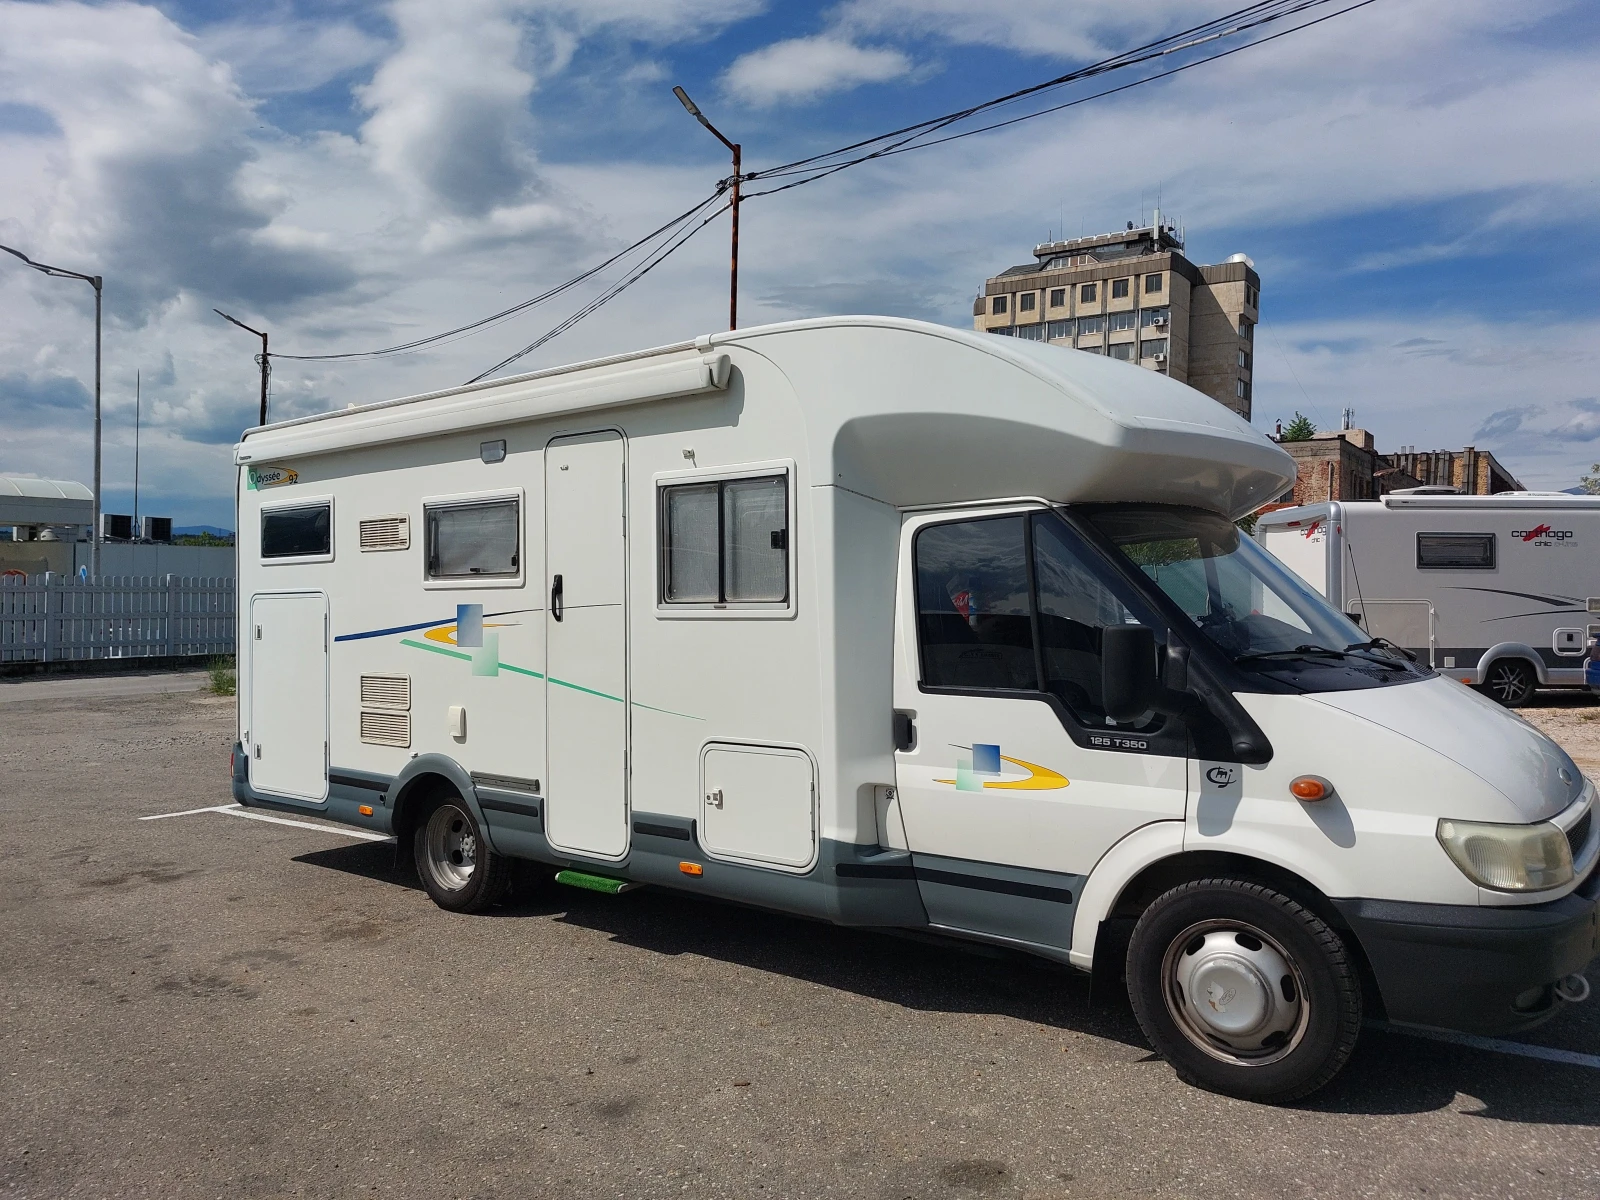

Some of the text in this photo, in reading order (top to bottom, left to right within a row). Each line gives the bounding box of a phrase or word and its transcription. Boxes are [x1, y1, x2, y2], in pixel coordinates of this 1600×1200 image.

[249, 471, 298, 484] Odyssée 92
[1090, 736, 1147, 749] 125 T350
